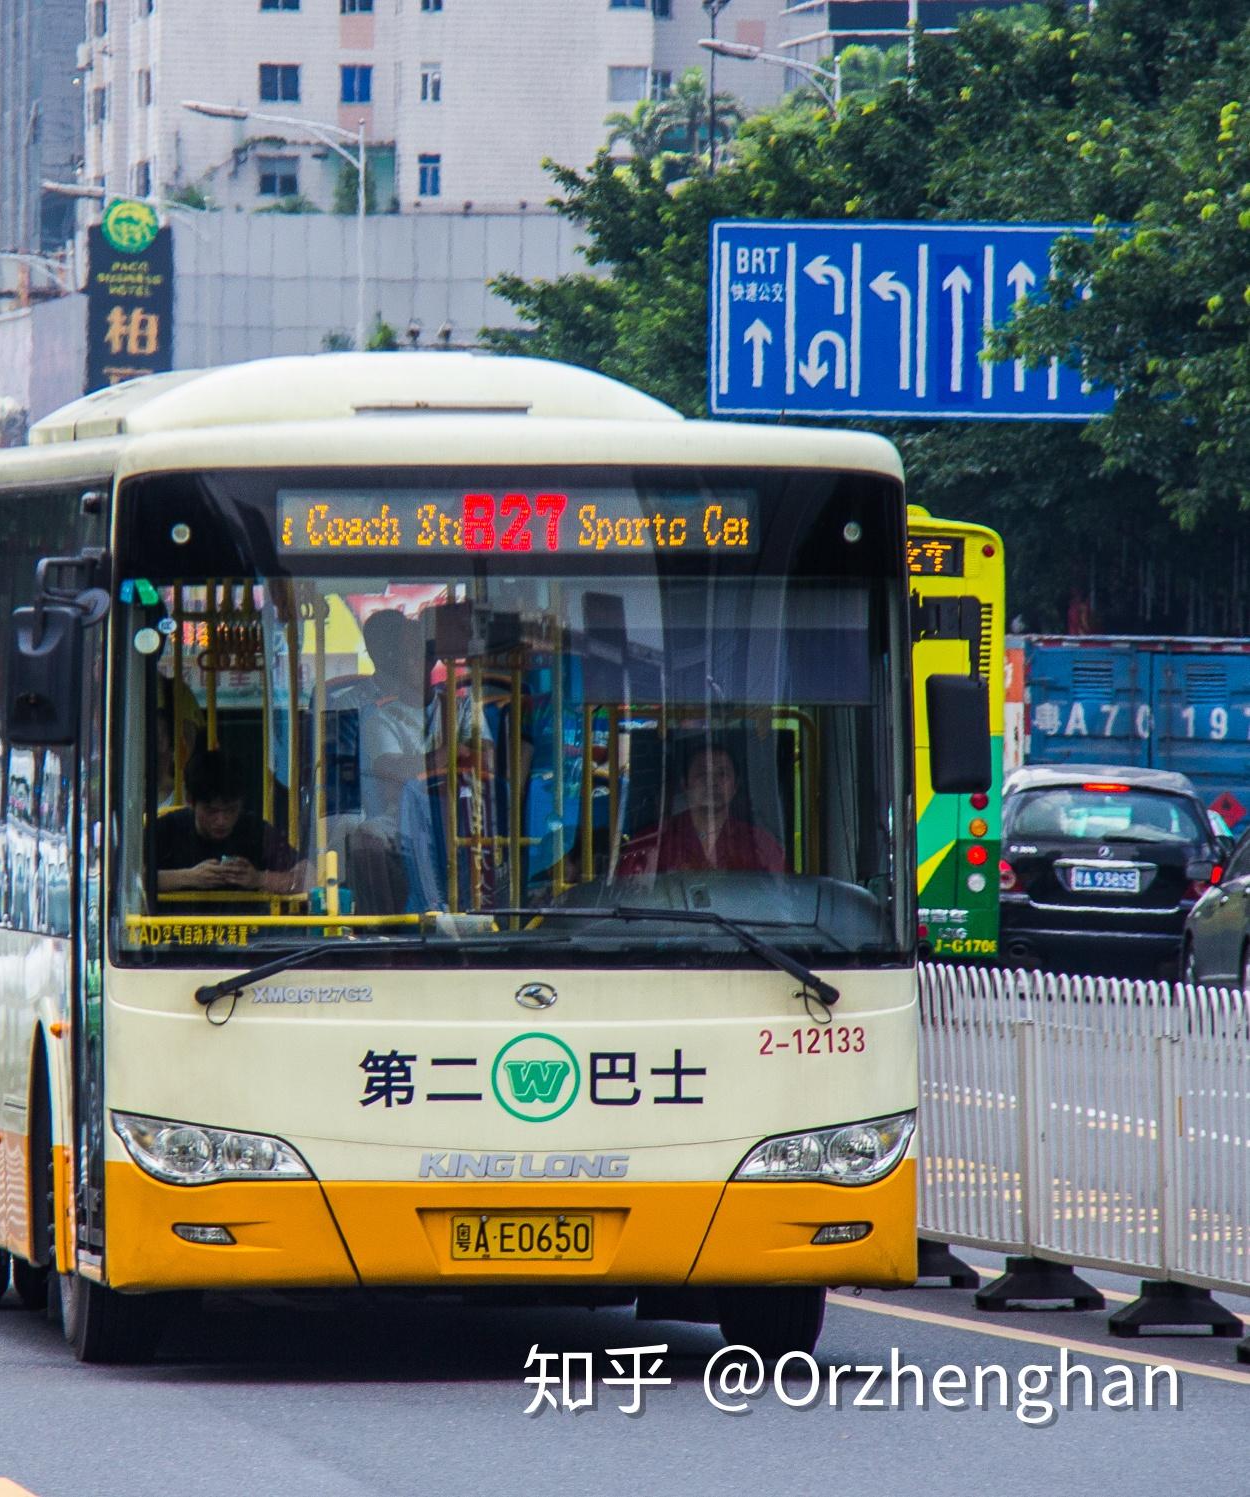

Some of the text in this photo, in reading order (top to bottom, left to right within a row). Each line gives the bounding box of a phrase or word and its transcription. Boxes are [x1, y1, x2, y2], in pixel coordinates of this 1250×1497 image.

[736, 247, 781, 274] BRT
[730, 281, 784, 303] 快速公交
[306, 504, 401, 546] Coach
[463, 494, 567, 551] B27
[252, 986, 373, 1004] XMQ6127G2
[758, 1026, 866, 1056] 2-12133
[358, 1048, 483, 1109] 第二
[588, 1048, 708, 1106] 巴士
[418, 1153, 630, 1178] KING LONG
